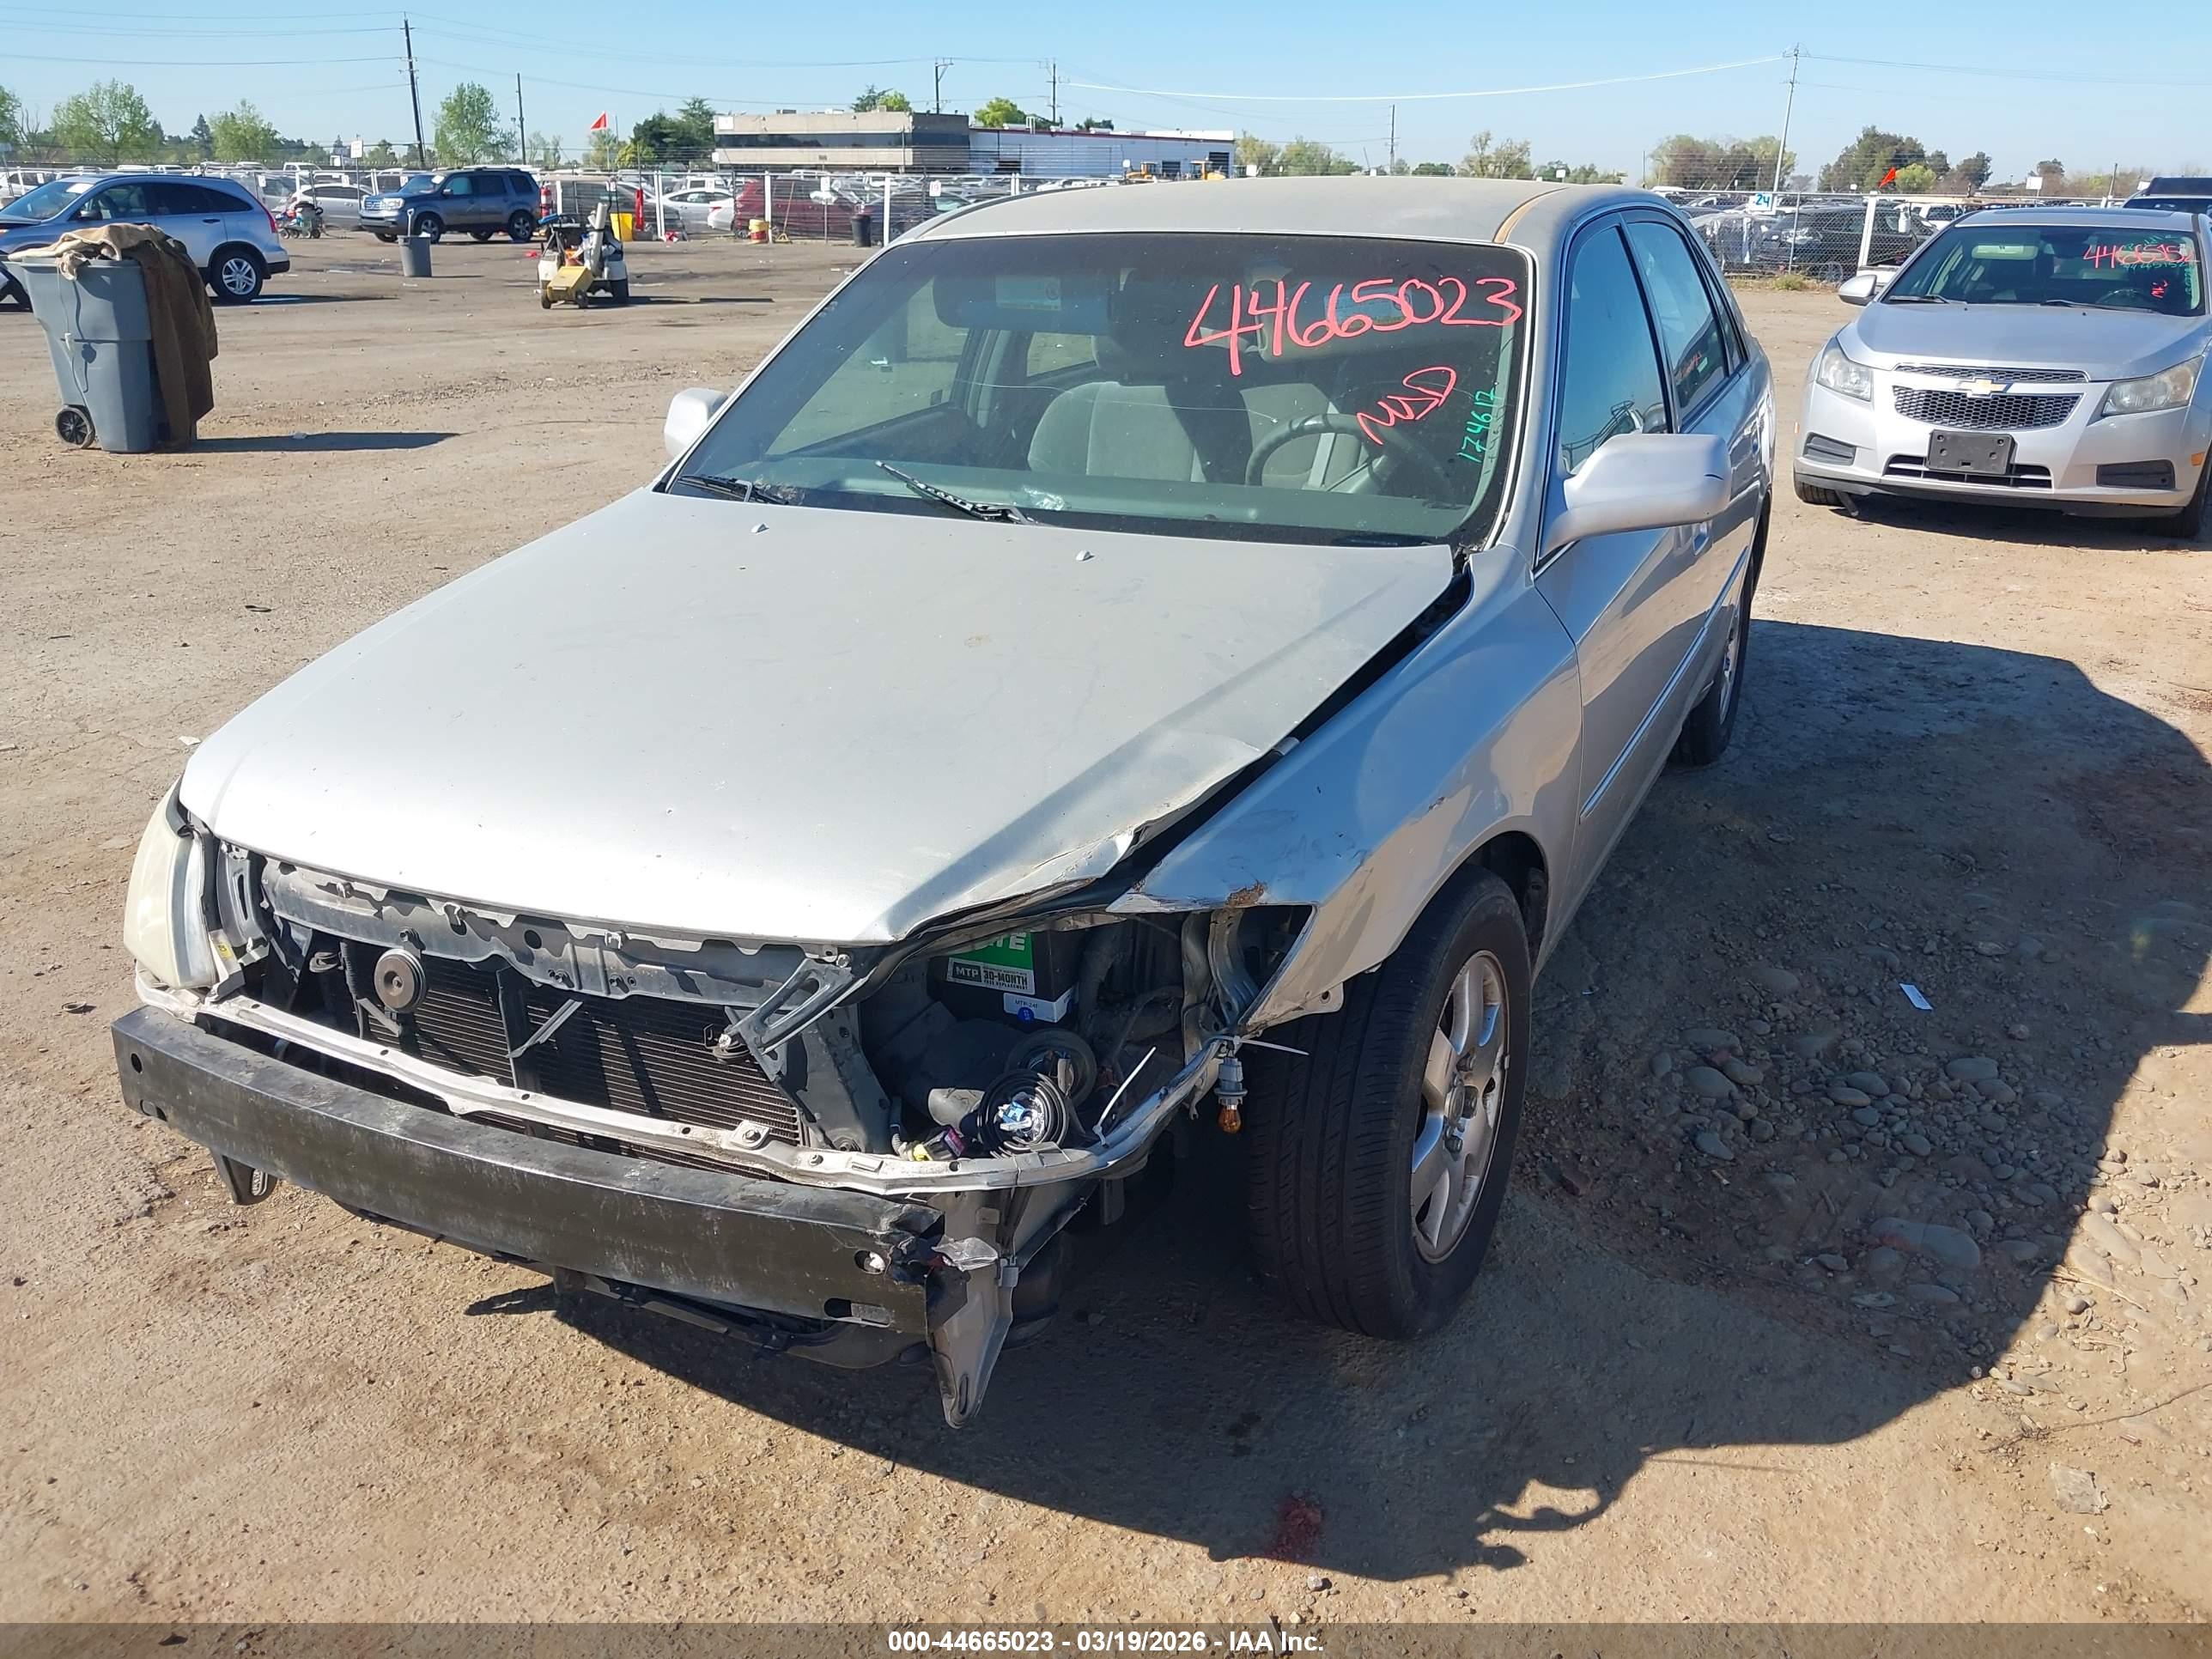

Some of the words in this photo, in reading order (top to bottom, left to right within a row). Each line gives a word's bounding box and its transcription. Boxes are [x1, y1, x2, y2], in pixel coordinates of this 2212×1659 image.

[1755, 193, 1771, 208] 24
[1183, 277, 1523, 377] 44665023
[954, 965, 980, 978] MTP
